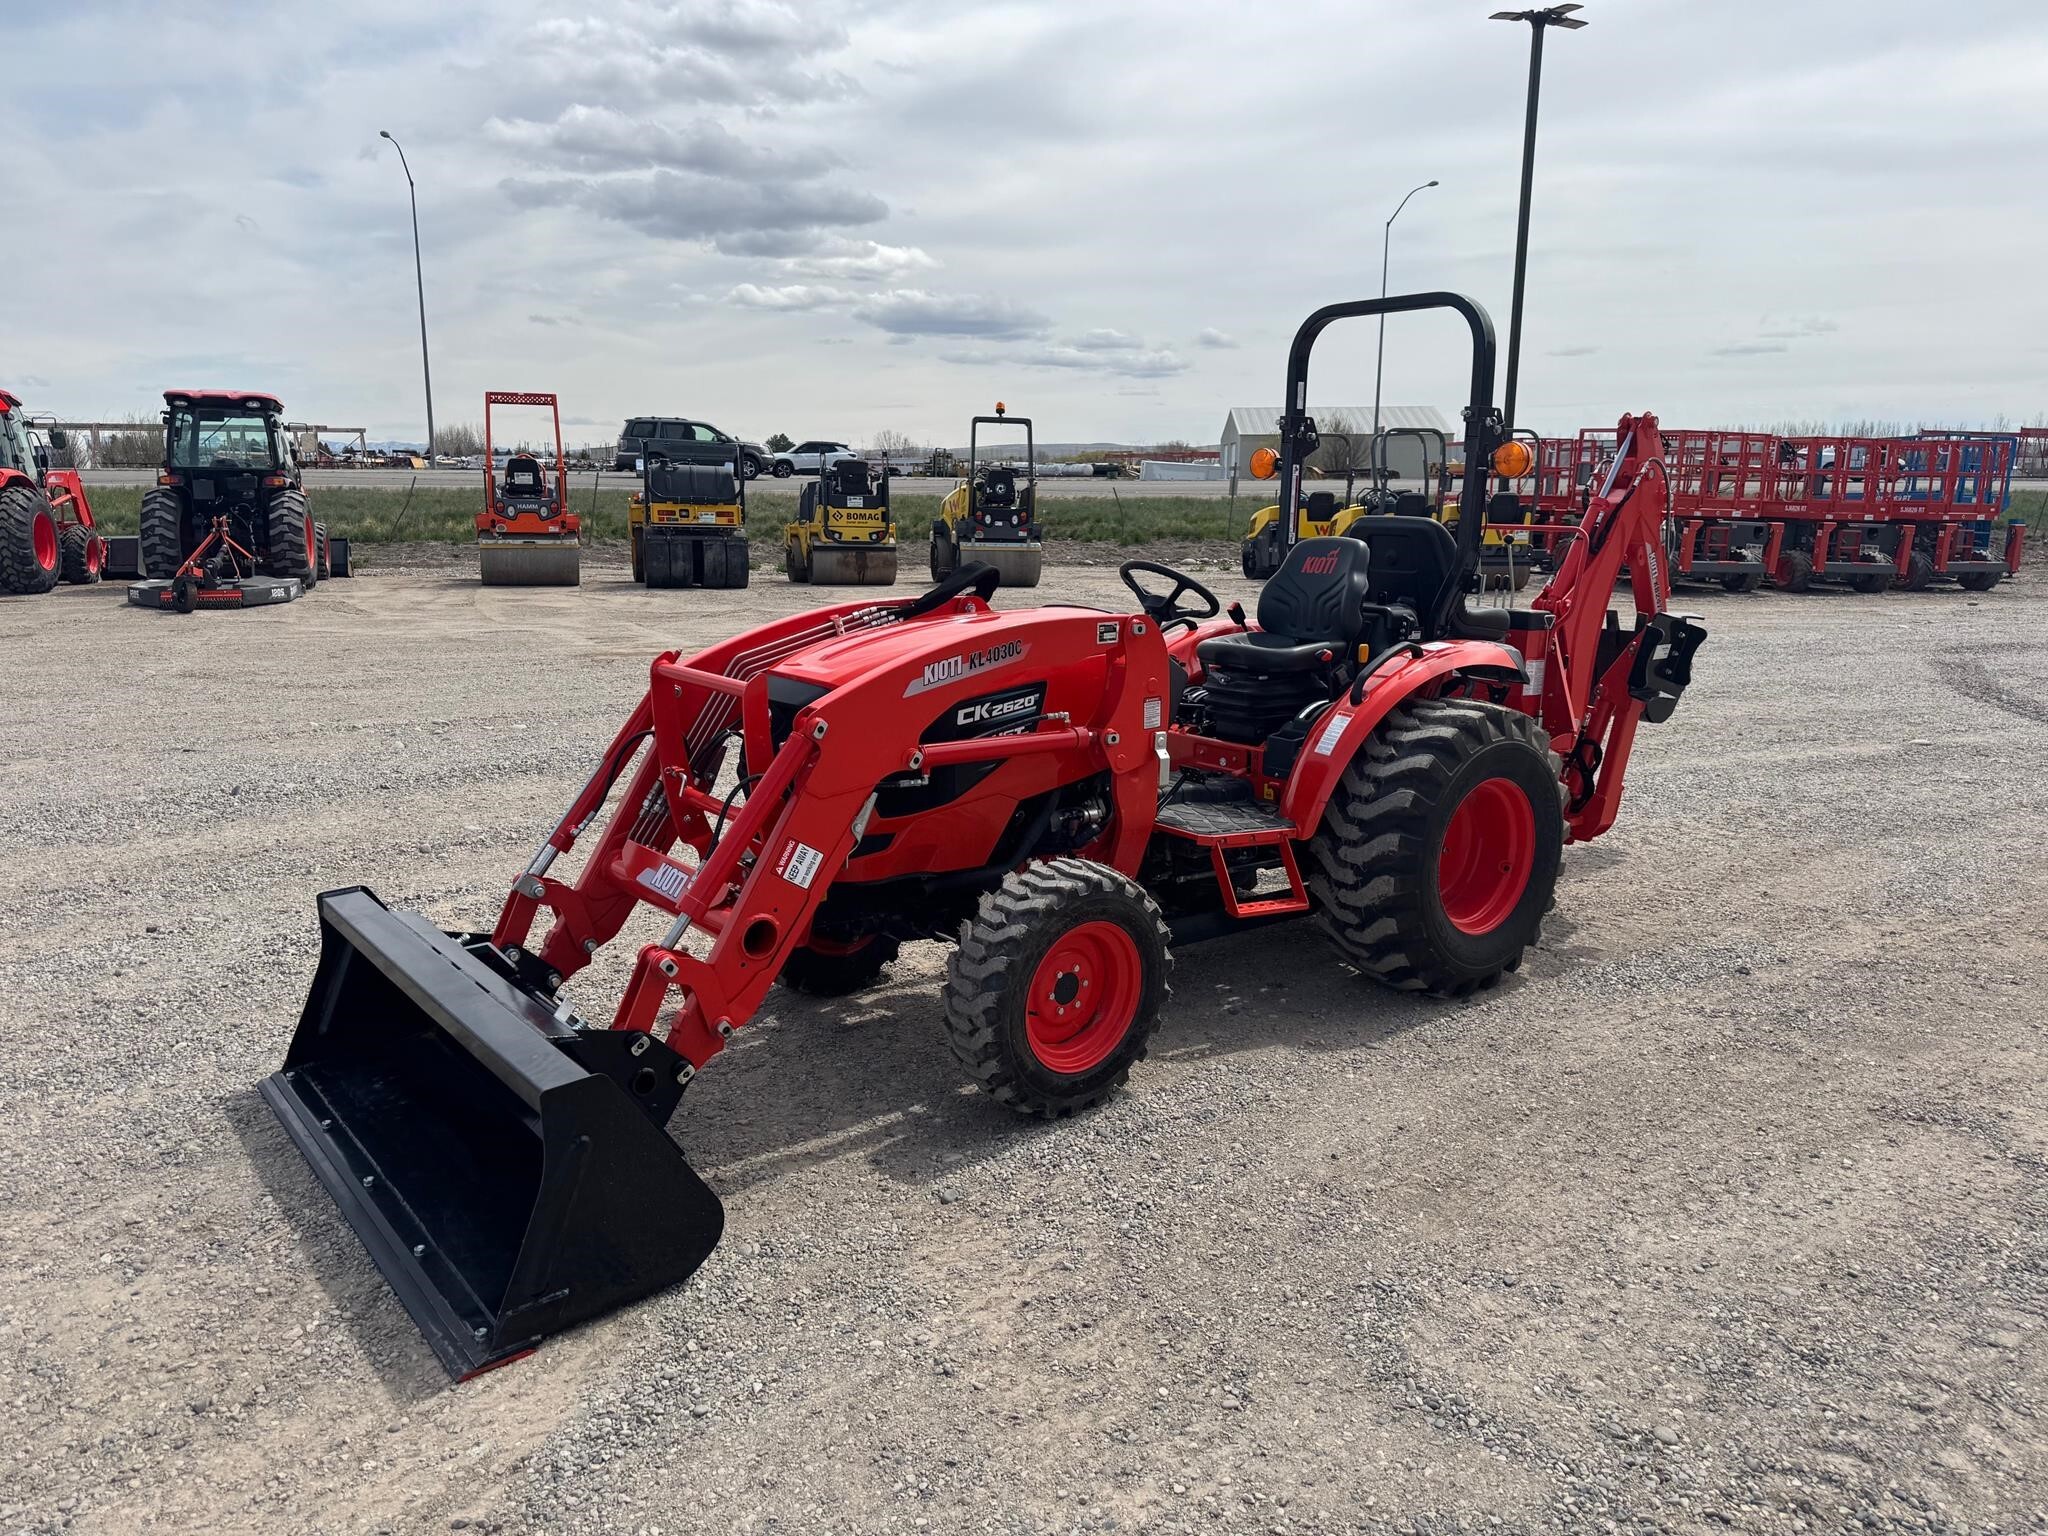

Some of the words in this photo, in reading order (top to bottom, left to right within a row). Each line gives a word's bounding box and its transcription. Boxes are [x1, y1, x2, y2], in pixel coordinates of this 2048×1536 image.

[846, 512, 880, 521] BOMAG
[1301, 556, 1338, 574] KIOTI
[1649, 552, 1659, 578] KIOTI
[923, 655, 963, 686] KIOTI
[968, 639, 1023, 670] KL4030C
[779, 840, 796, 866] WARNING
[786, 864, 800, 881] KEEP
[795, 846, 810, 866] AWAY
[650, 862, 690, 899] KIOTI
